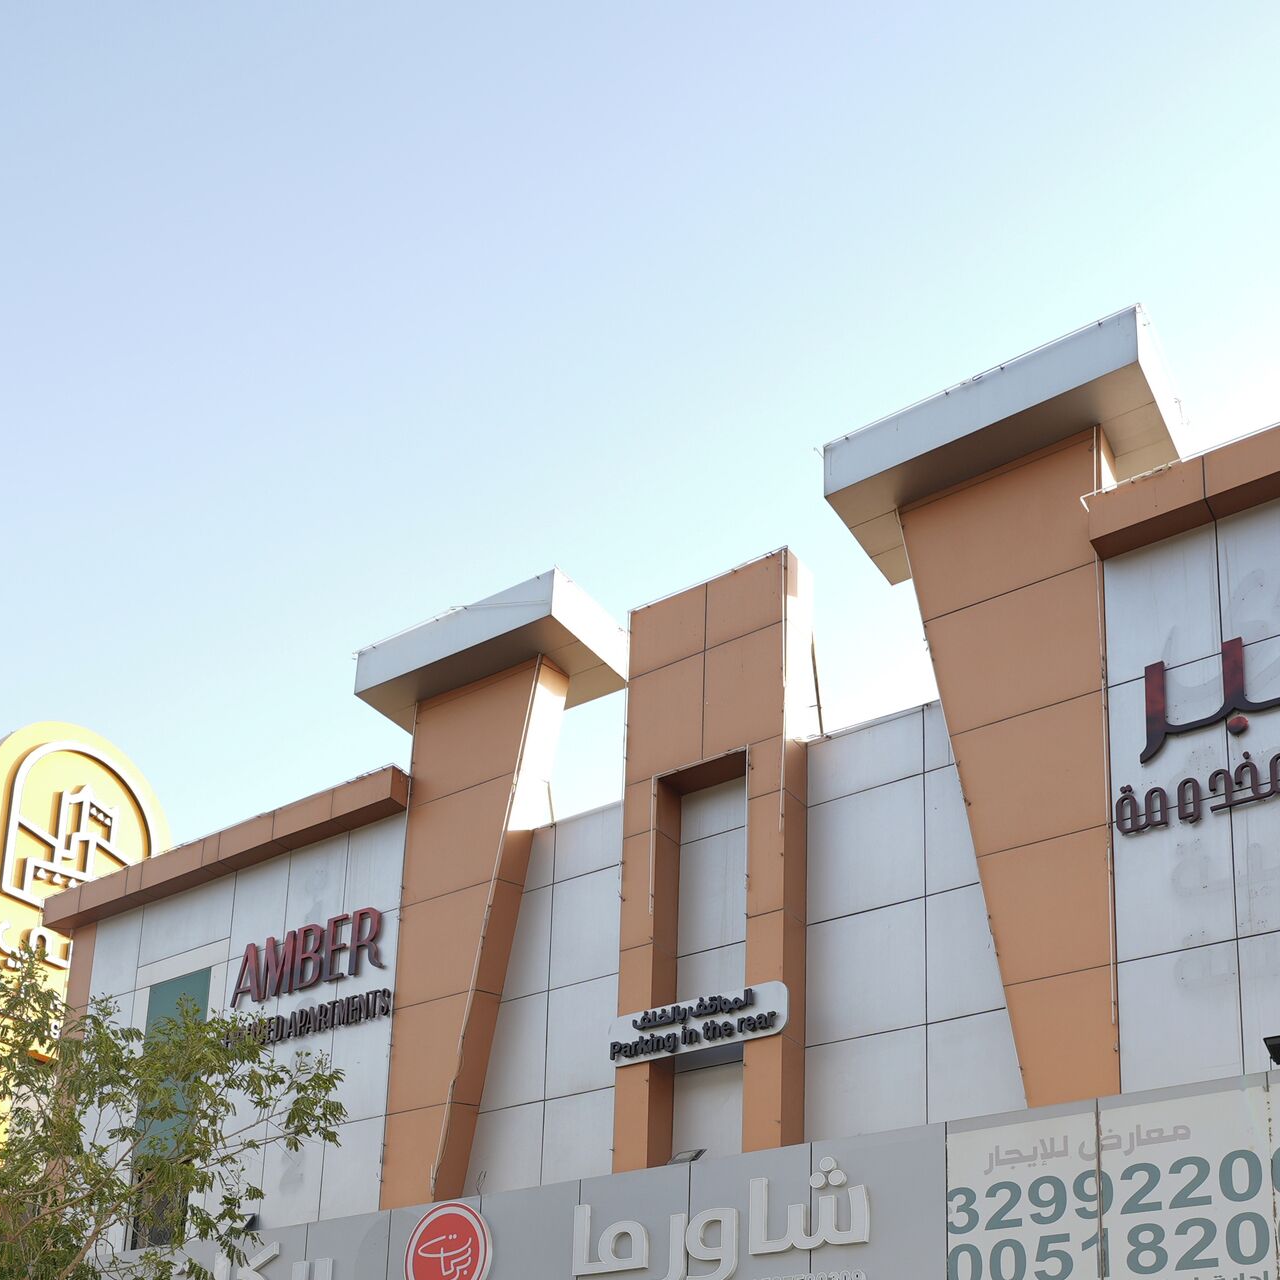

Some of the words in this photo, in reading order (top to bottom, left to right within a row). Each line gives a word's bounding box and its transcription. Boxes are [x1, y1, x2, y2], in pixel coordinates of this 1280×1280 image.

[229, 907, 386, 1008] AMBER
[286, 988, 392, 1039] APARTMENTS
[632, 1004, 688, 1031] بالخلف
[689, 988, 754, 1018] المواقف
[610, 1032, 677, 1061] Parking
[681, 1024, 699, 1045] in
[702, 1019, 734, 1041] the
[738, 1010, 777, 1032] rear
[984, 1135, 1069, 1175] للإيجار
[1078, 1121, 1191, 1161] معارض
